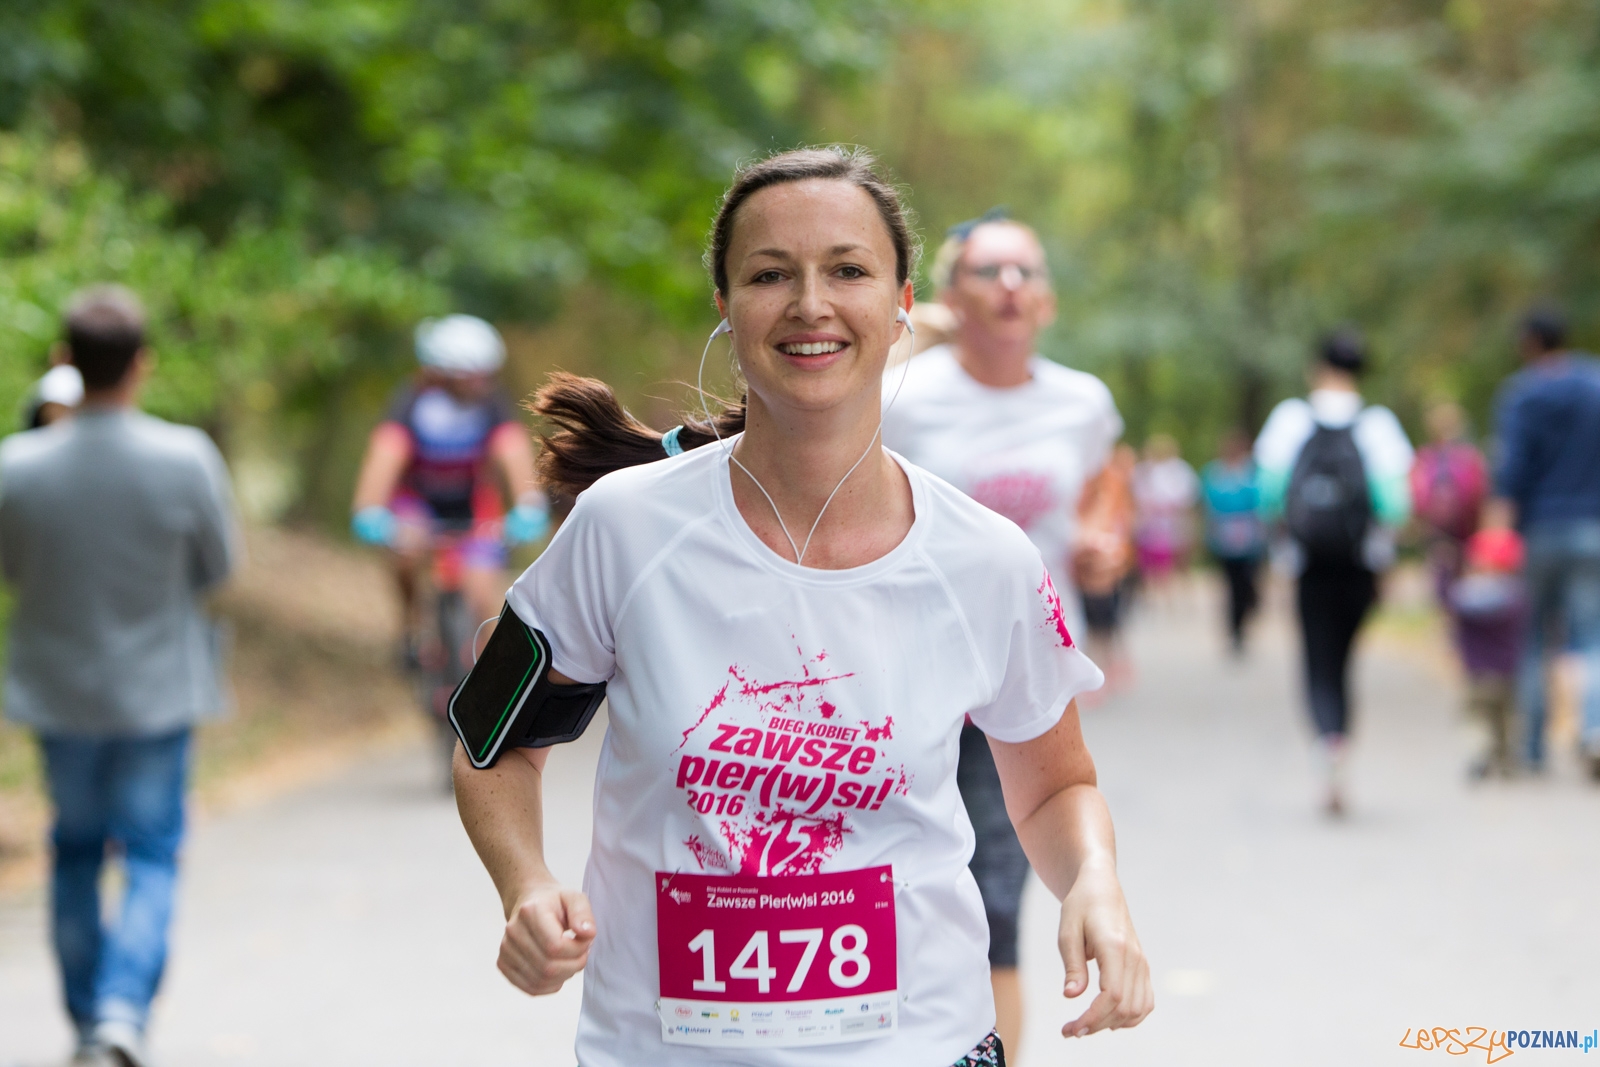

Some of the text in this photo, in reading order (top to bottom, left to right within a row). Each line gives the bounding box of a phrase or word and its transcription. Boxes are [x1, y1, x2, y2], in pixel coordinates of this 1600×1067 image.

[768, 716, 861, 742] BIEG KOBIET
[708, 723, 876, 775] zawsze
[676, 754, 895, 815] pier(w)si!
[687, 789, 746, 816] 2016
[707, 893, 757, 909] Zawsze
[760, 892, 818, 911] Pier(w)si
[820, 888, 855, 907] 2016
[688, 924, 871, 994] 1478
